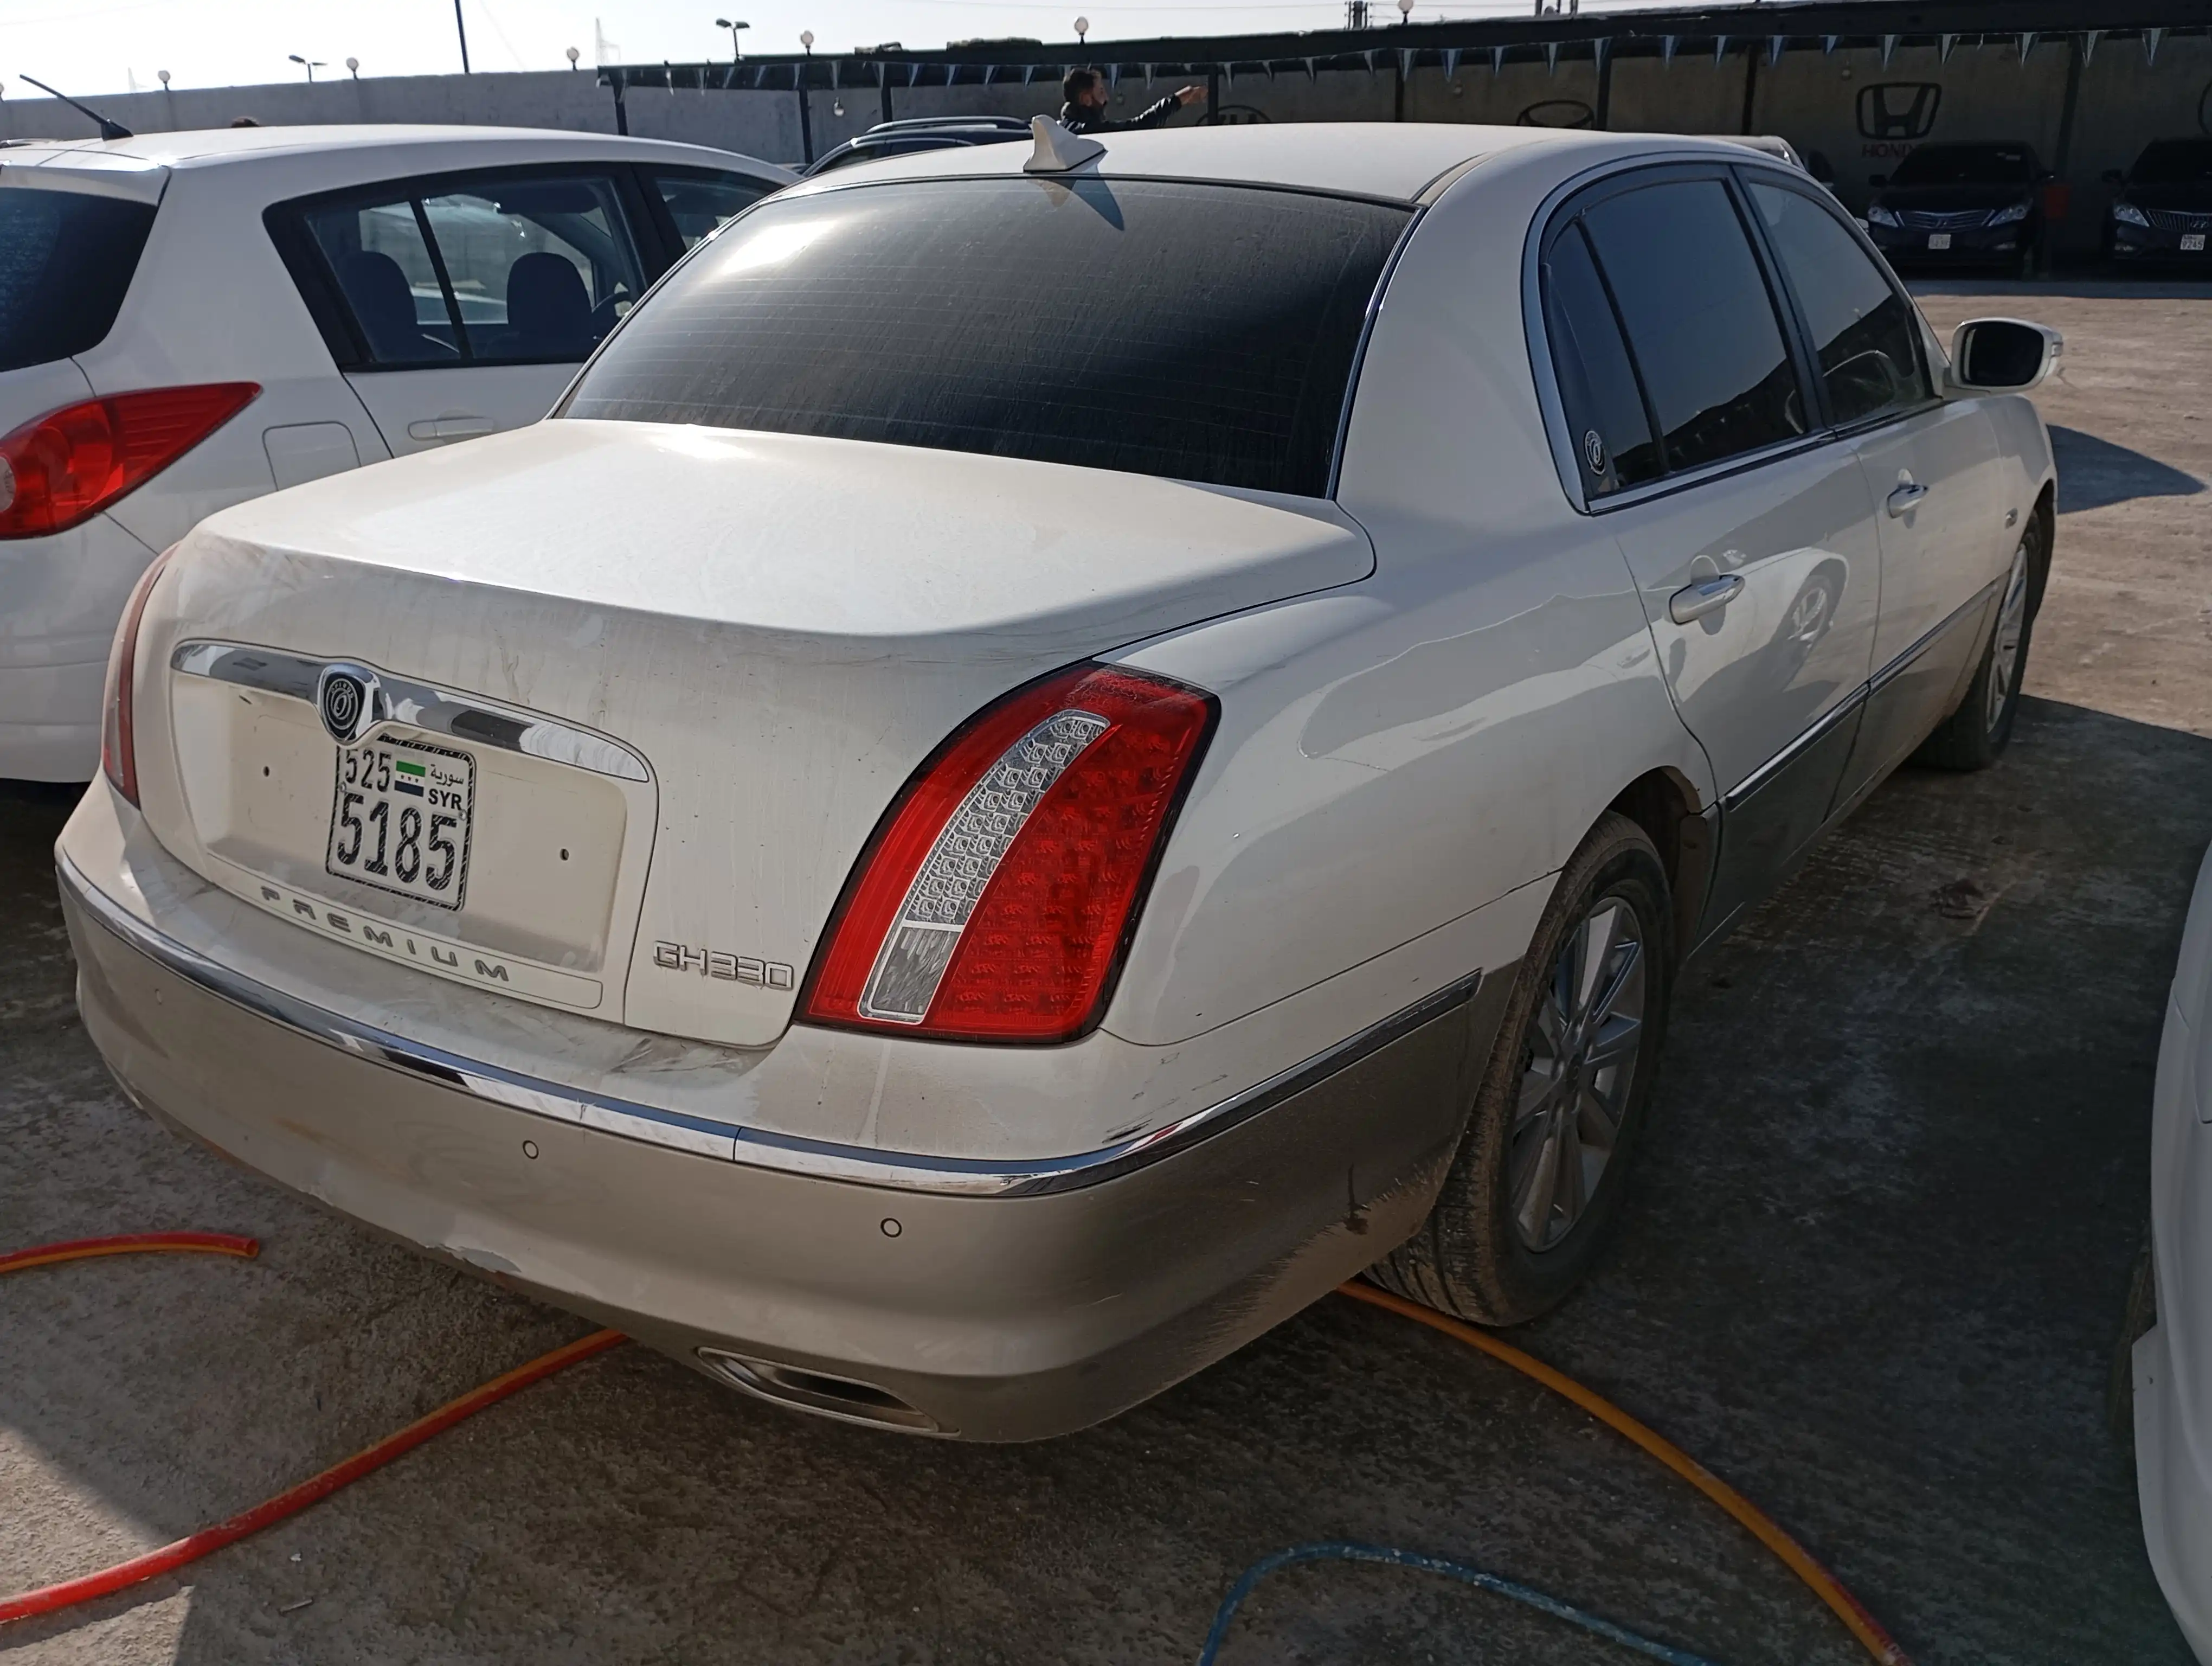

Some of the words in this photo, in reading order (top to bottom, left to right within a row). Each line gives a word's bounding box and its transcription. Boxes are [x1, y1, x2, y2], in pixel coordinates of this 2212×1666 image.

[1862, 144, 1912, 158] HOND
[345, 748, 391, 792] 525
[430, 764, 464, 787] سورية
[428, 789, 462, 811] SYR
[337, 792, 458, 891] 5185
[261, 886, 510, 982] PREMIUM
[653, 940, 794, 991] GH330
